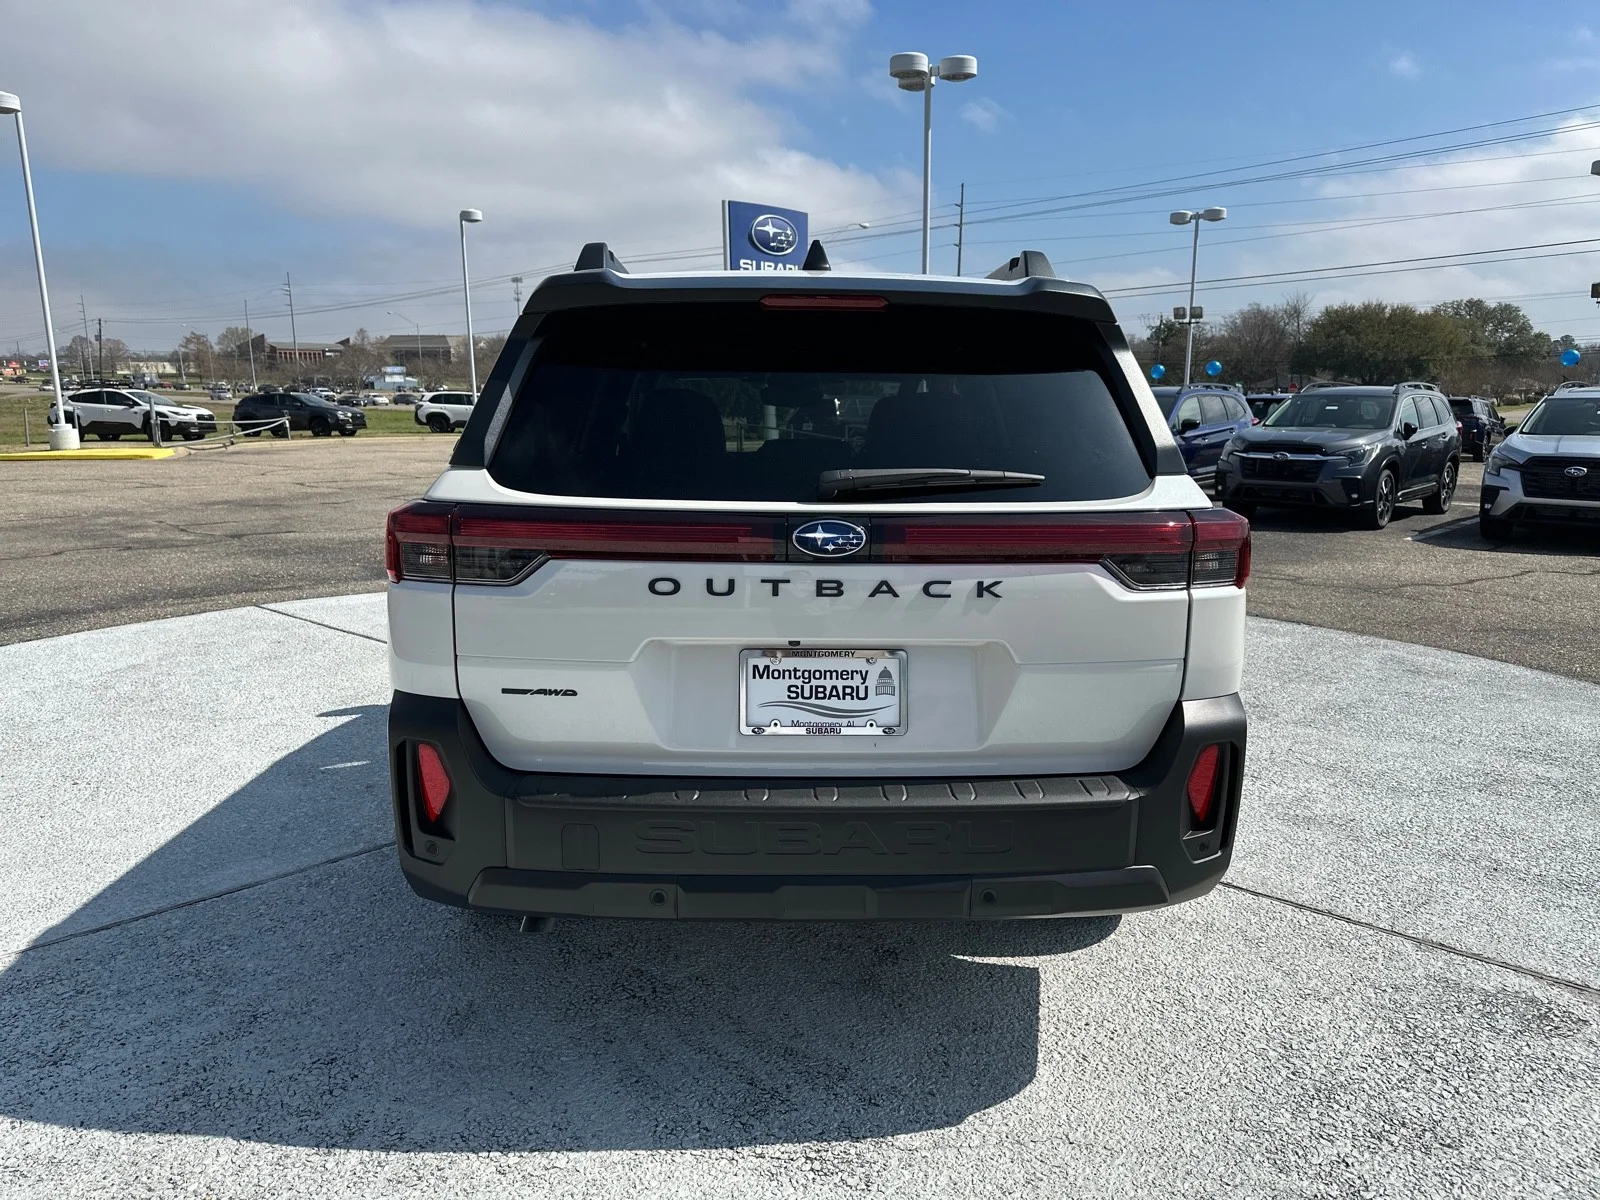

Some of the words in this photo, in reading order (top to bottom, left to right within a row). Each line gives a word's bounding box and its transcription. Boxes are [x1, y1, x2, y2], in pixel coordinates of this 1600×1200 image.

[739, 258, 799, 271] SUBAR
[648, 577, 1004, 599] OUTBACK
[790, 650, 857, 658] MONTGOMERY
[752, 664, 869, 685] Montgomery
[529, 688, 578, 697] AWD
[787, 684, 869, 701] SUBARU
[805, 727, 842, 735] SUBARU
[634, 819, 1016, 855] SUBARU
